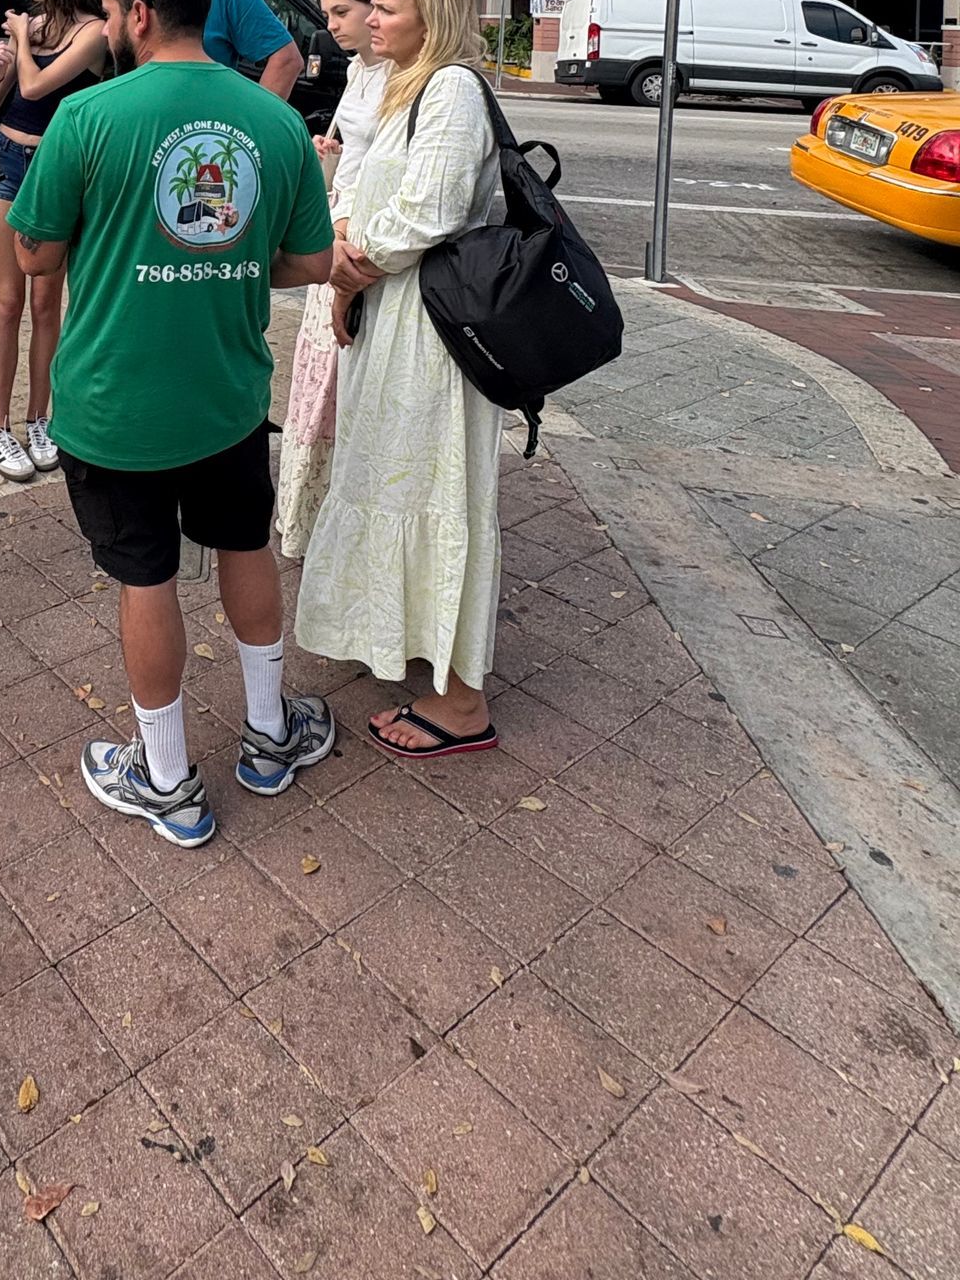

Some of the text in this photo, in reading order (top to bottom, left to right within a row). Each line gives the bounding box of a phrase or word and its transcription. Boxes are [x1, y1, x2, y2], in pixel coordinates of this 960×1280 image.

[151, 147, 165, 167] KEY
[161, 128, 184, 149] WEST,
[183, 122, 194, 133] IN
[194, 120, 212, 130] ONE
[214, 121, 233, 133] DAY
[232, 128, 256, 150] YOUR
[895, 121, 930, 141] 1479
